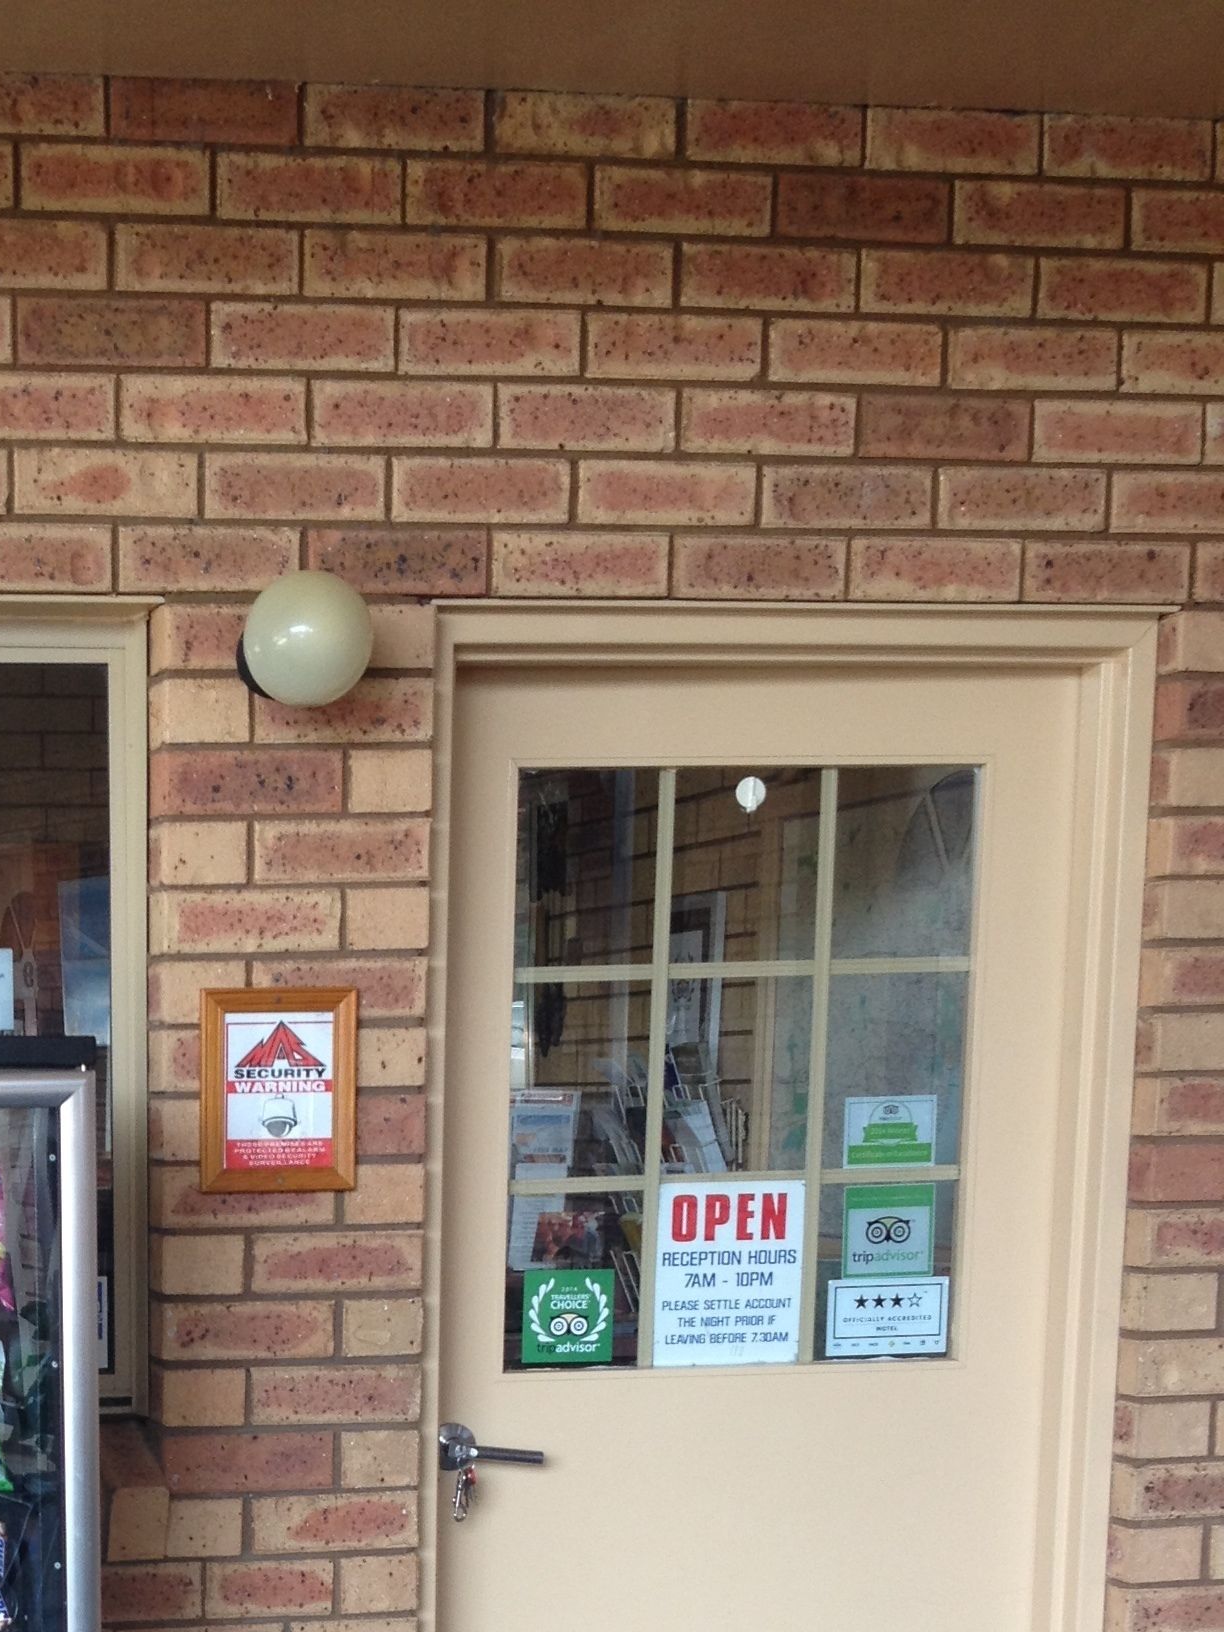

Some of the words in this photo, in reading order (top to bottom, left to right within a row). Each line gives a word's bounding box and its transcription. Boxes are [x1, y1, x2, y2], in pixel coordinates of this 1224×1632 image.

[233, 1068, 327, 1079] SECURITY
[234, 1081, 326, 1093] WARNING
[671, 1193, 788, 1242] OPEN
[662, 1250, 742, 1267] RECEPTION
[748, 1249, 797, 1265] HOURS
[853, 1250, 920, 1265] tripadvisor
[684, 1273, 716, 1288] 7AM
[736, 1271, 774, 1287] 10PM
[551, 1300, 588, 1309] CHOICE
[662, 1300, 699, 1312] PLEASE
[704, 1299, 740, 1310] SETTLE
[745, 1297, 792, 1309] ACCOUNT
[678, 1317, 696, 1328] THE
[700, 1316, 731, 1327] NIGHT
[735, 1315, 764, 1326] PRIOR
[767, 1314, 776, 1325] IF
[665, 1334, 706, 1345] LEAVING
[710, 1332, 747, 1344] BEFORE
[751, 1331, 789, 1343] 7.30AM
[537, 1341, 597, 1355] tripadvisor
